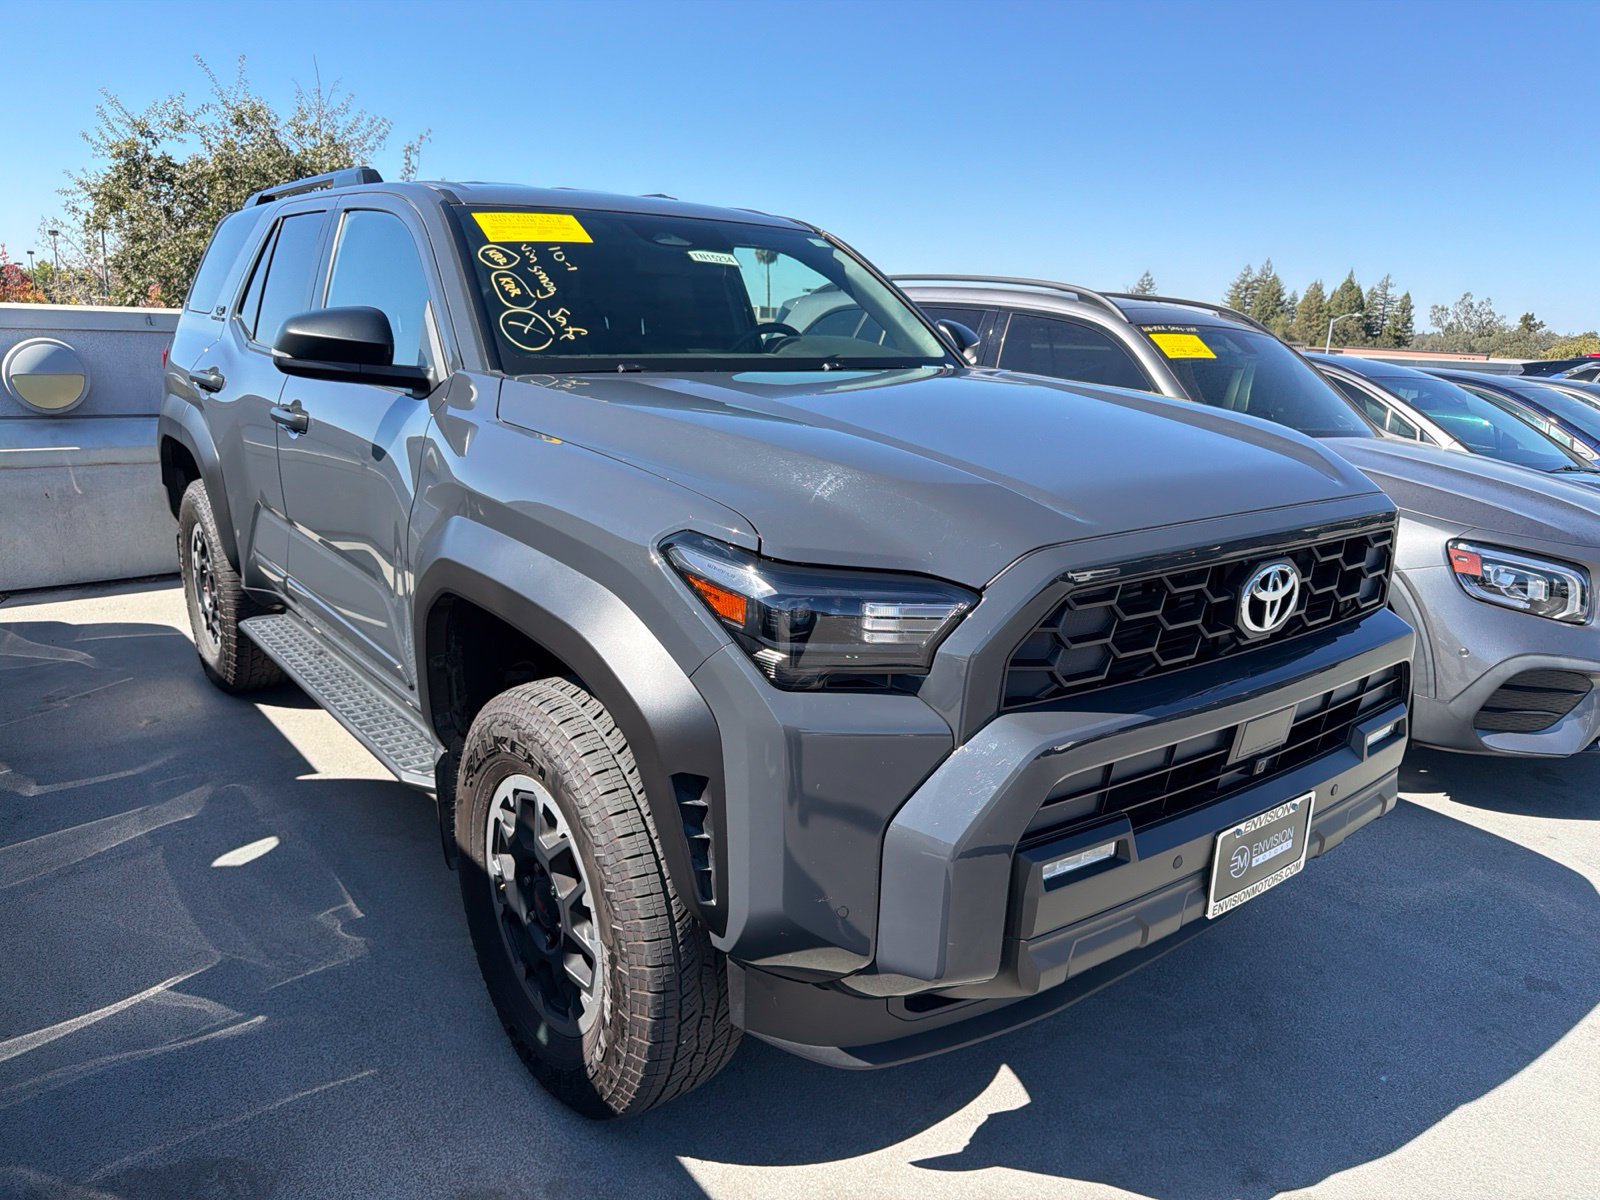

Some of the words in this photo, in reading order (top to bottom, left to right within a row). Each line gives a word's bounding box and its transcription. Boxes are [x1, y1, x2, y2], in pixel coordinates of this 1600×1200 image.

[1244, 803, 1292, 831] ENVISION
[1252, 826, 1295, 856] ENVISION
[1254, 843, 1290, 864] MOTORS
[1211, 860, 1302, 917] ENVISIONMOTORS.COM
